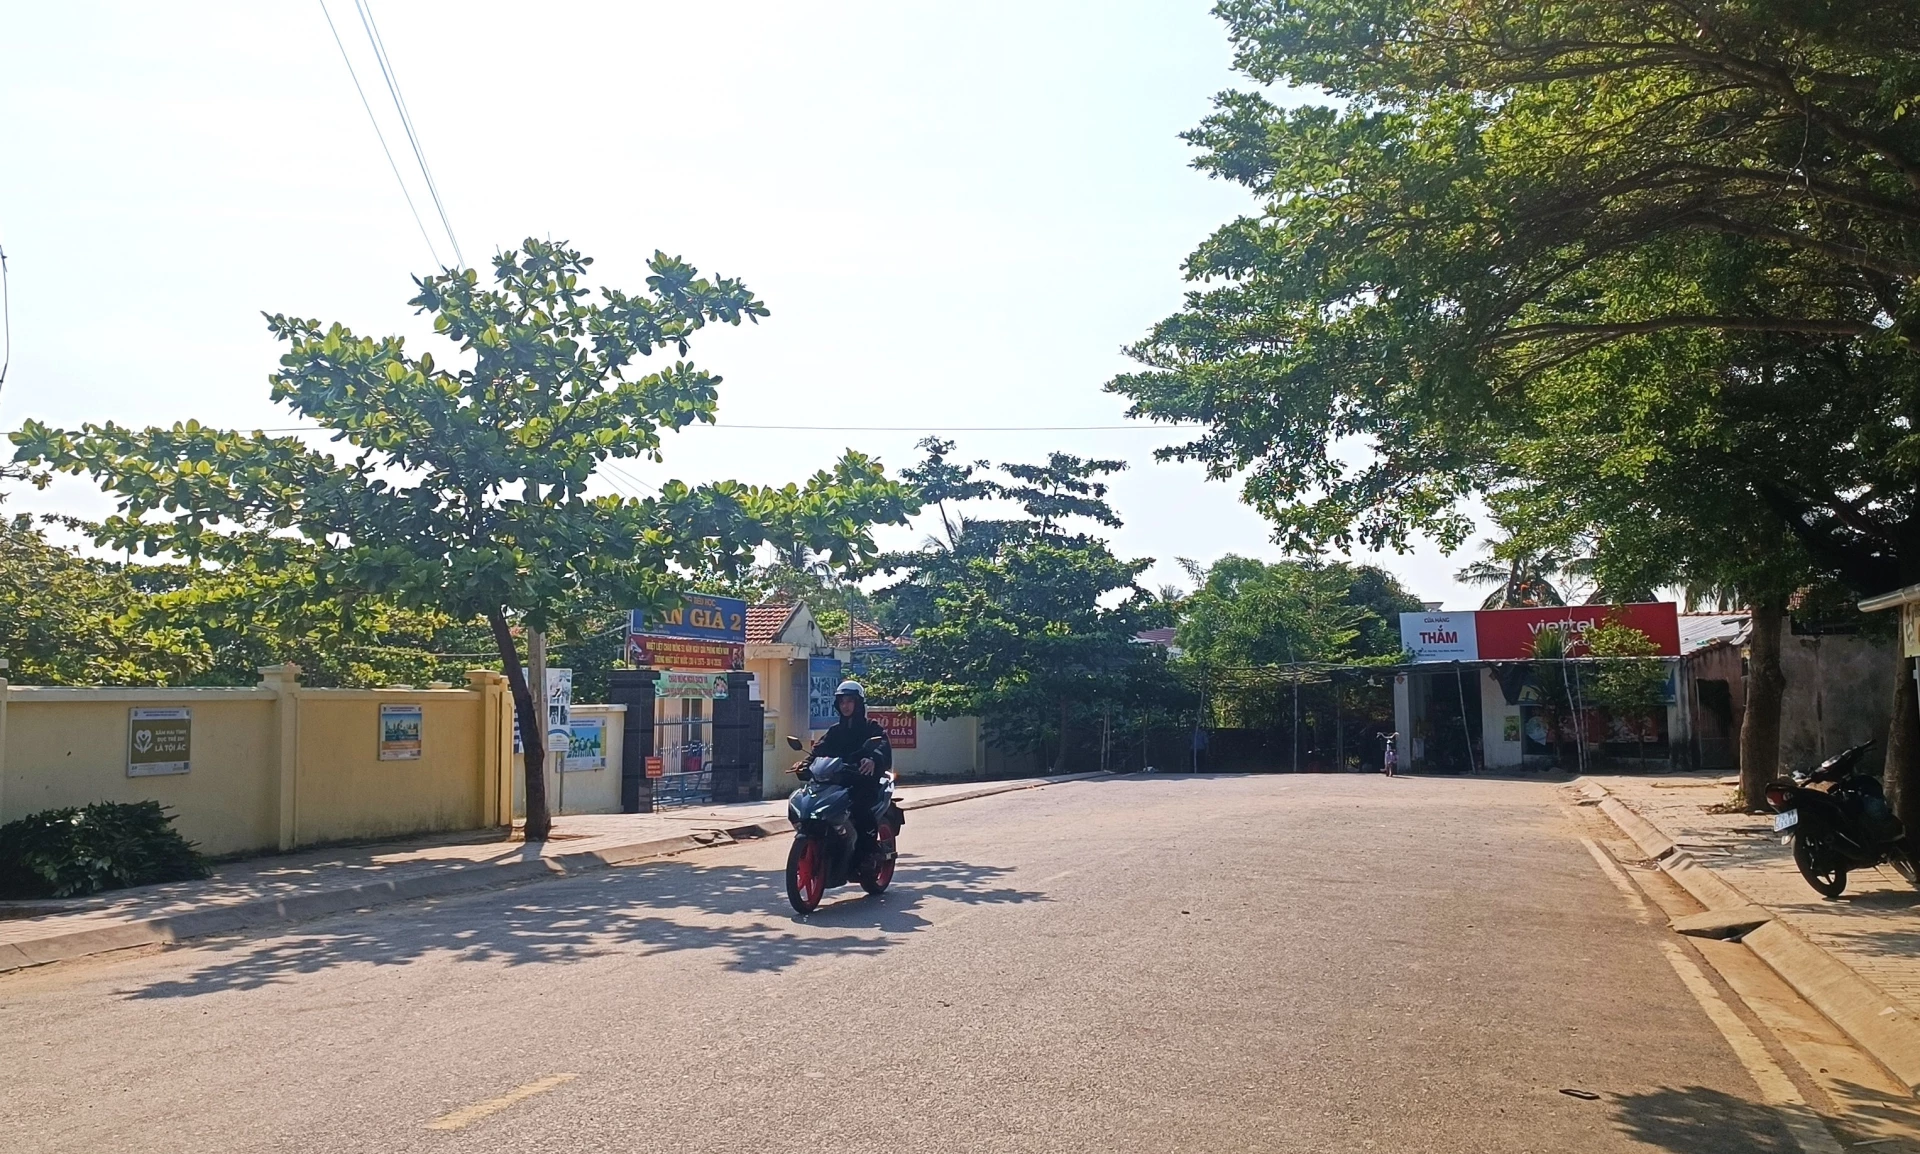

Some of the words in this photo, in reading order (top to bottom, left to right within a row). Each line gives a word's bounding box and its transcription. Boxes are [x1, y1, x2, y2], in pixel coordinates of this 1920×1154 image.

[690, 607, 725, 630] GIÃ
[730, 613, 742, 631] 2
[164, 743, 175, 753] TỘI
[176, 742, 186, 751] ÁC
